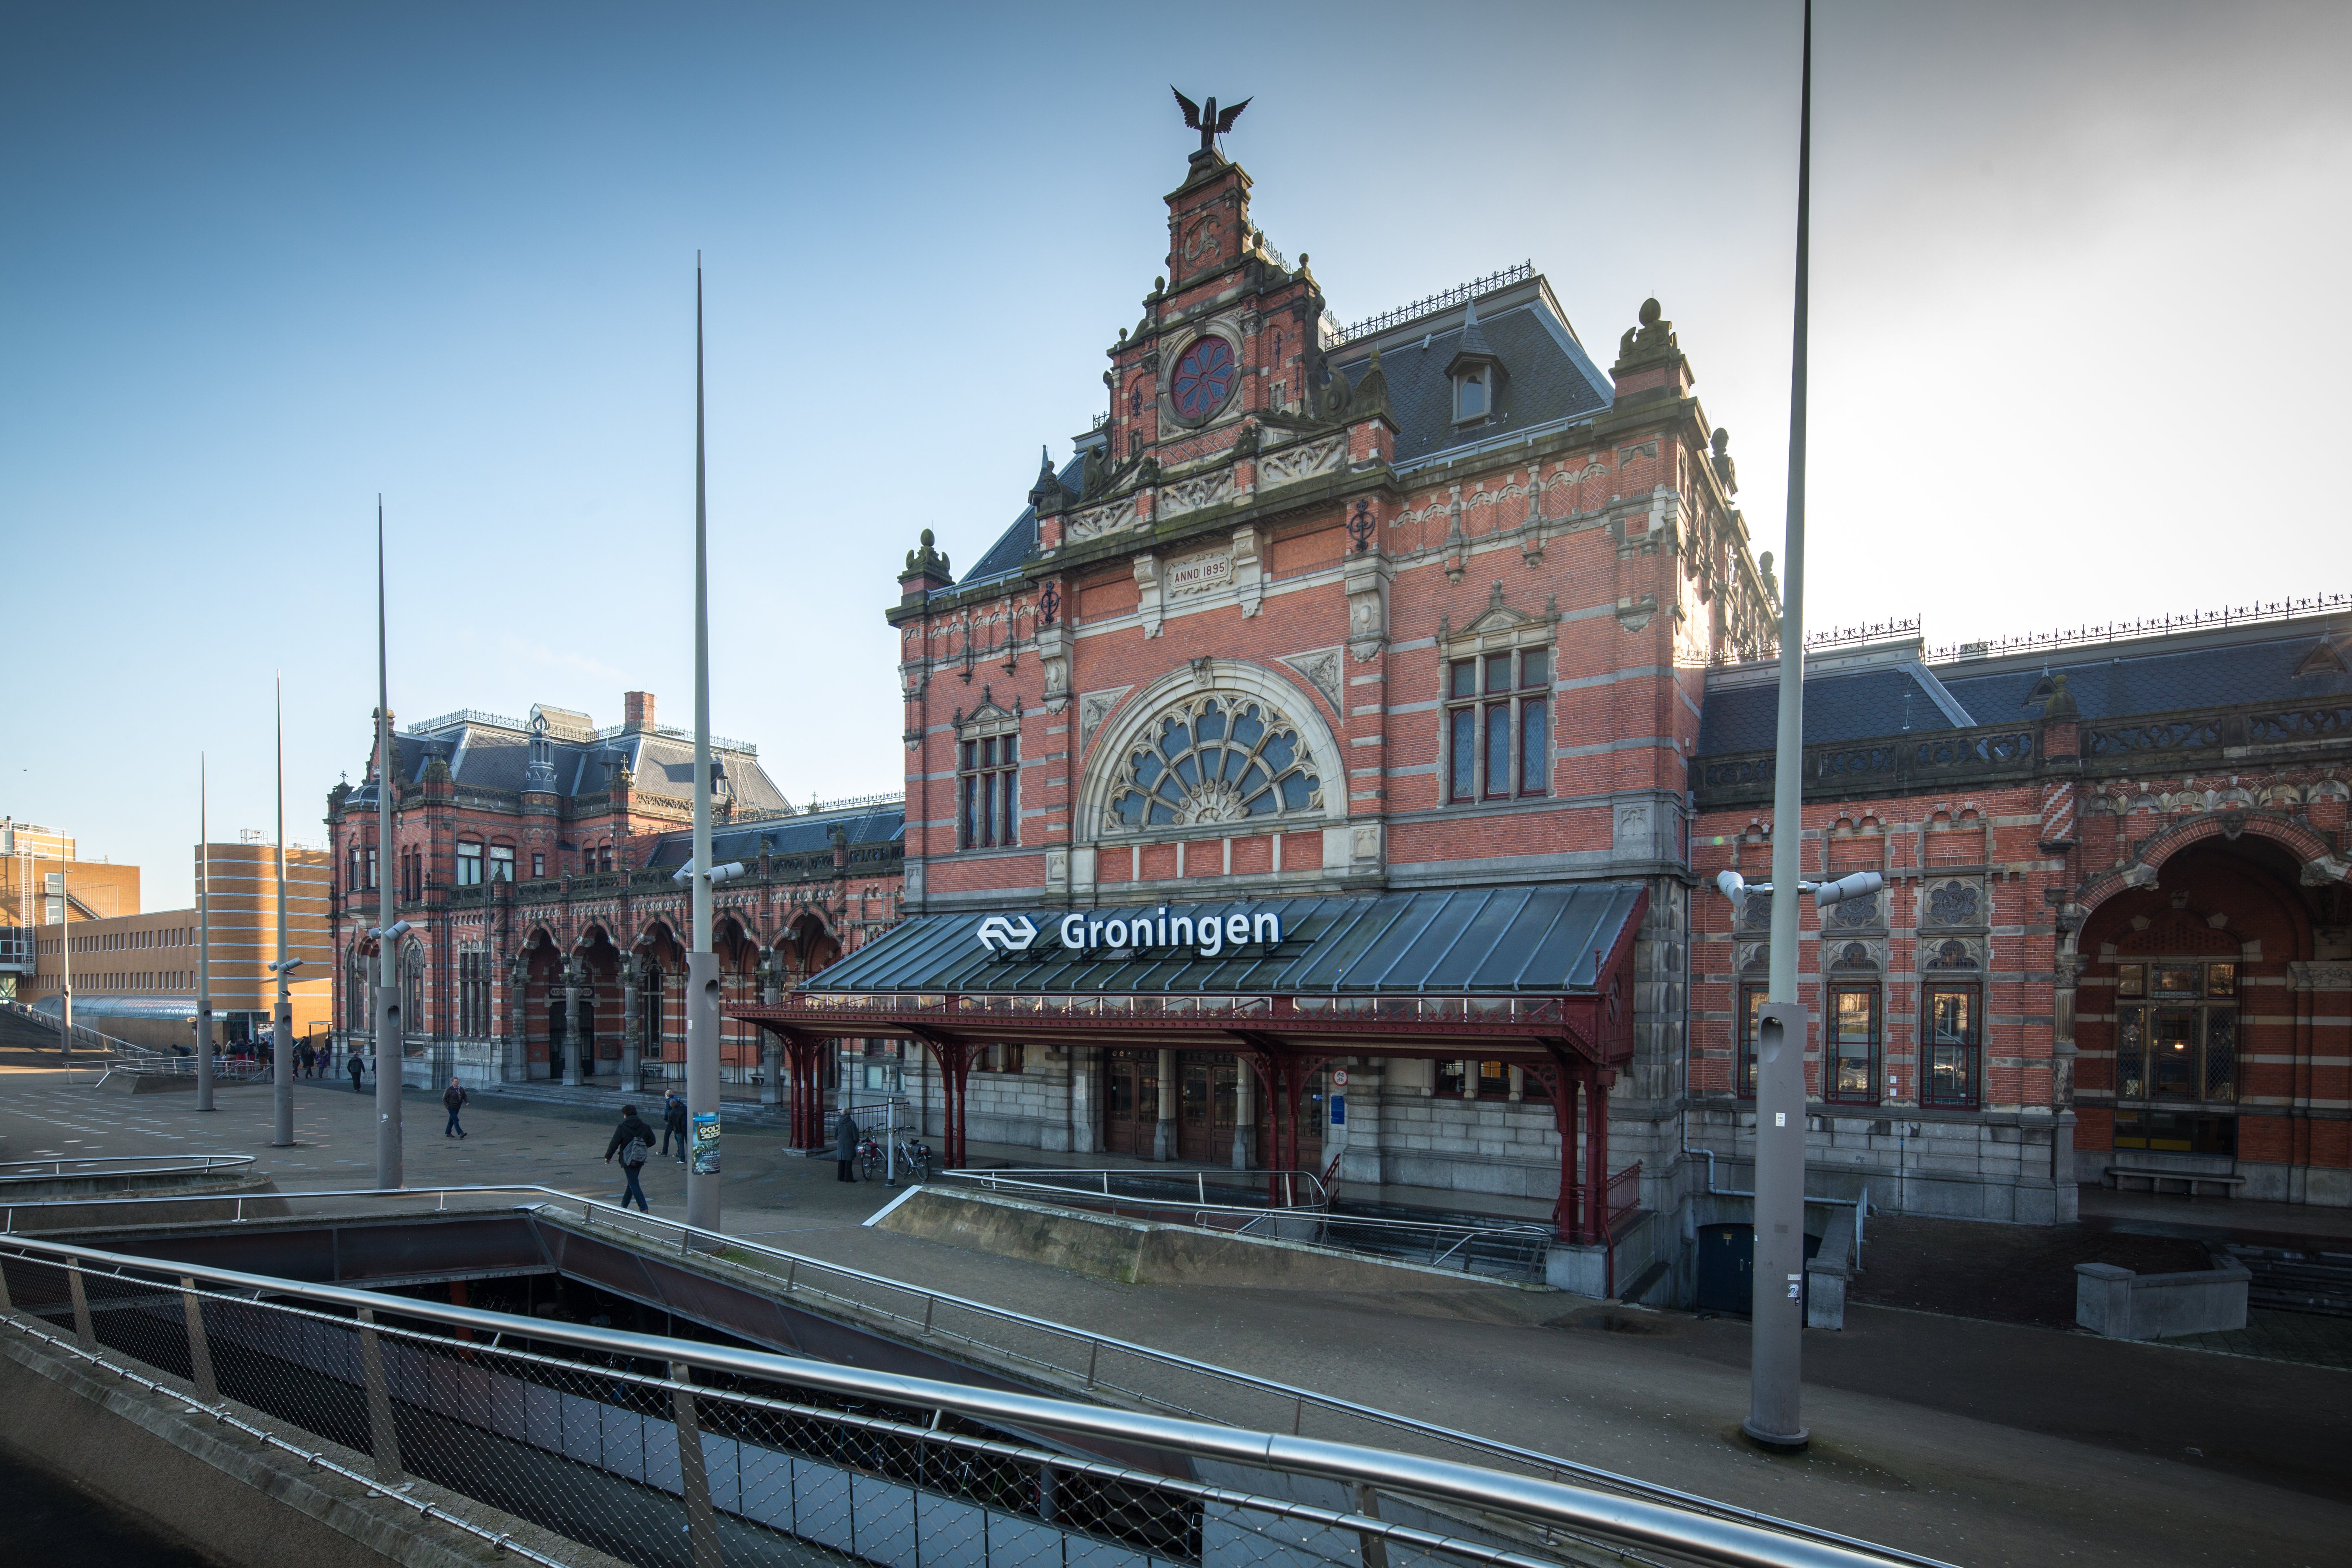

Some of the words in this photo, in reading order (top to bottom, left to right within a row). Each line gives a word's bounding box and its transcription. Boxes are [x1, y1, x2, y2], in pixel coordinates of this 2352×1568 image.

[1175, 568, 1198, 583] ANNO
[1203, 562, 1225, 577] 1895
[1061, 907, 1281, 957] Groningen
